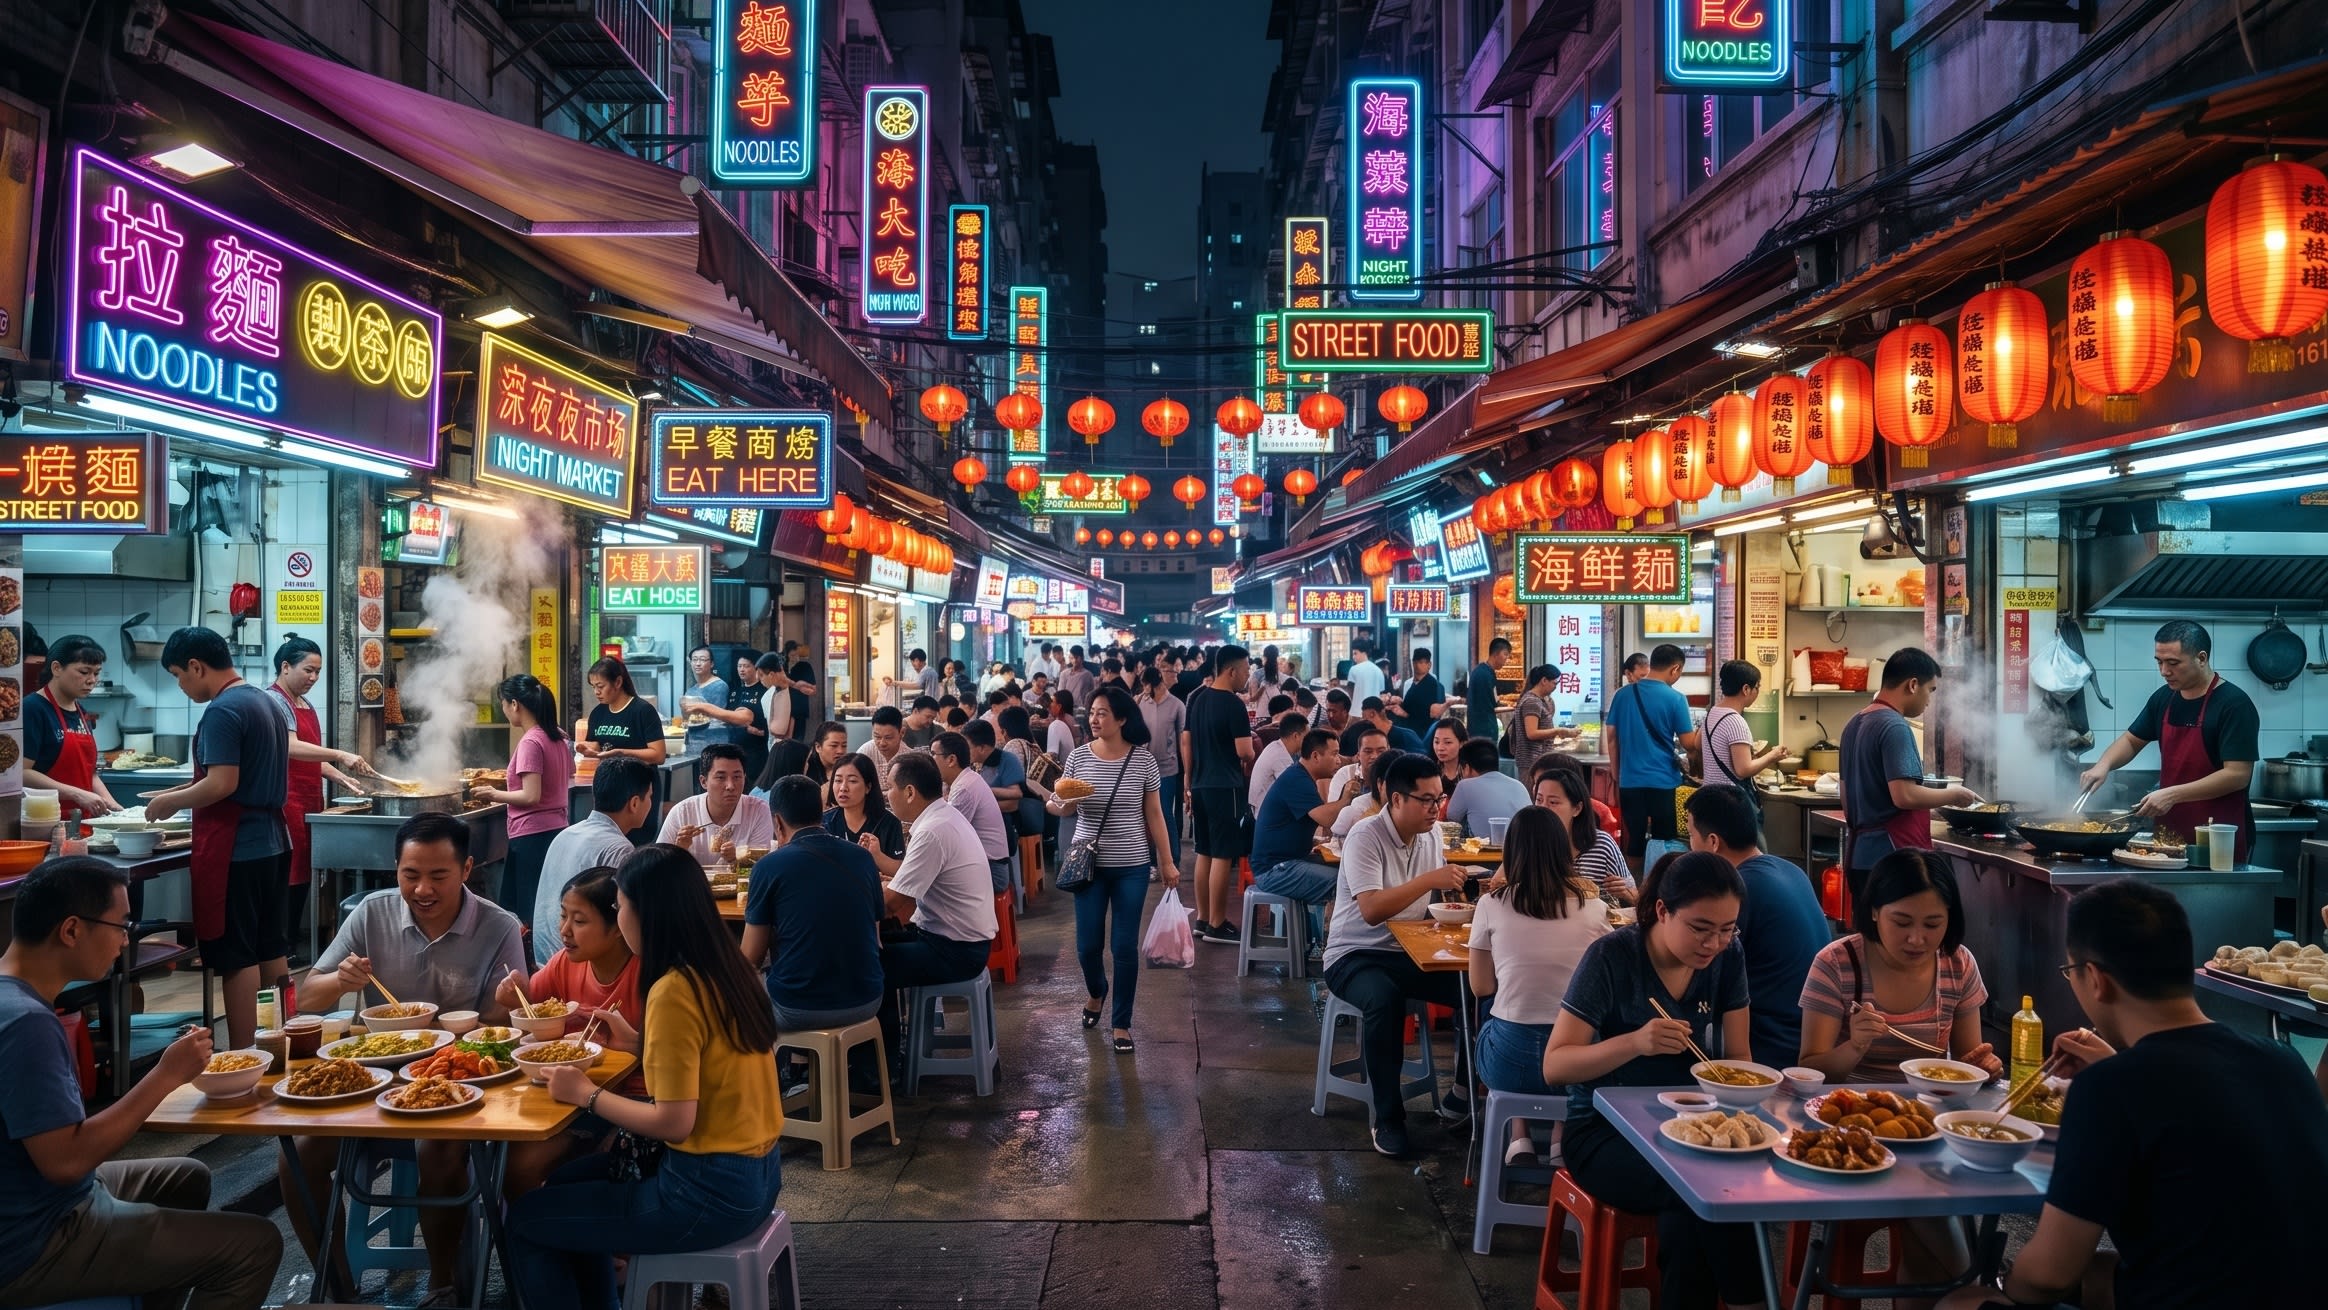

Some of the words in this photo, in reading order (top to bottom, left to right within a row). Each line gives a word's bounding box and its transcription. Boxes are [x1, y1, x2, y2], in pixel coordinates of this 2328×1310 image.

[1683, 41, 1772, 61] NOODLES
[724, 141, 800, 163] NOODLES
[100, 187, 281, 357] 拉麵
[1363, 260, 1408, 272] NIGHT
[1294, 323, 1383, 358] STREET
[1396, 323, 1459, 358] FOOD
[99, 322, 278, 413] NOODLES
[497, 436, 554, 480] NIGHT
[557, 454, 624, 499] MARKET
[668, 467, 724, 493] EAT
[739, 467, 817, 493] HERE
[0, 501, 76, 520] STREET
[81, 501, 139, 520] FOOD
[608, 587, 645, 605] EAT
[649, 587, 697, 605] HOSE
